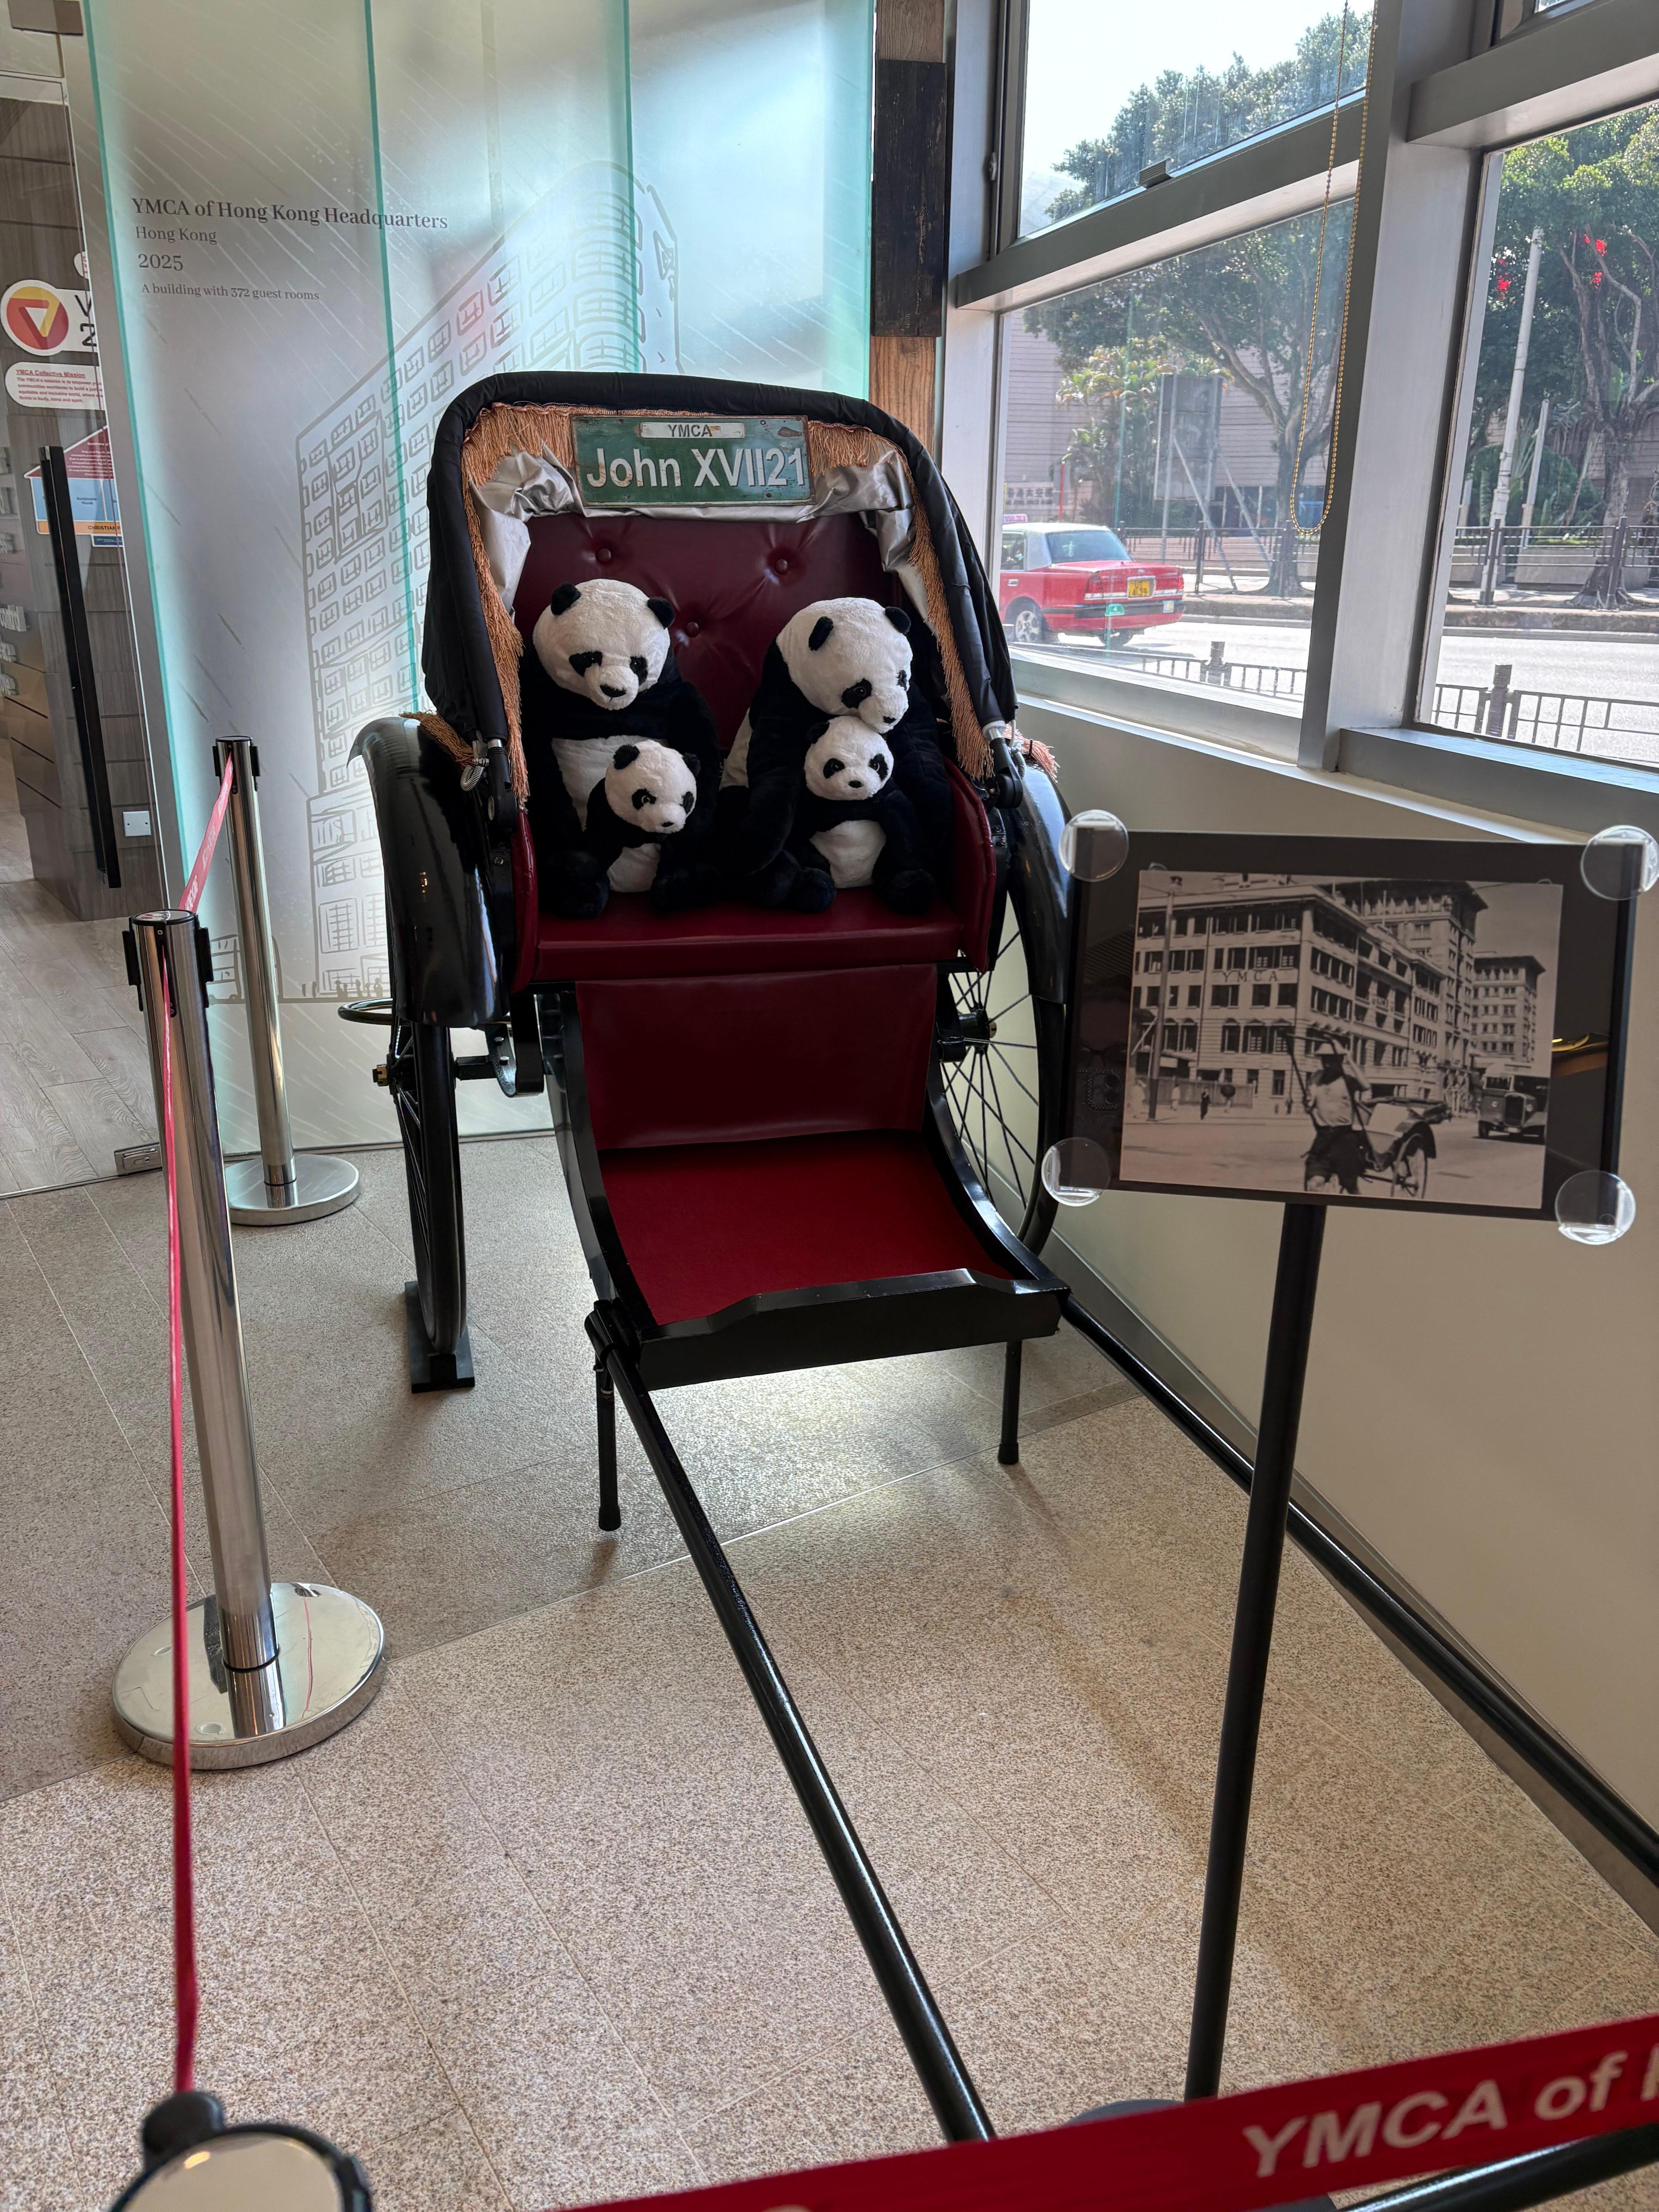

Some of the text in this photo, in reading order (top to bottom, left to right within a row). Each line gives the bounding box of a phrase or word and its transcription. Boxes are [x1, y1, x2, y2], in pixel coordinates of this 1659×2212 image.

[131, 198, 448, 229] YMCA of Hong Kong Headquarters
[136, 227, 217, 245] Hong Kong
[138, 254, 183, 271] 2025
[142, 283, 319, 300] A building with 372 guest rooms
[667, 424, 713, 437] YMCA
[586, 448, 804, 488] John XVII21
[1223, 970, 1278, 983] YMCA
[1242, 2078, 1508, 2178] YMCA
[1533, 2050, 1628, 2121] of
